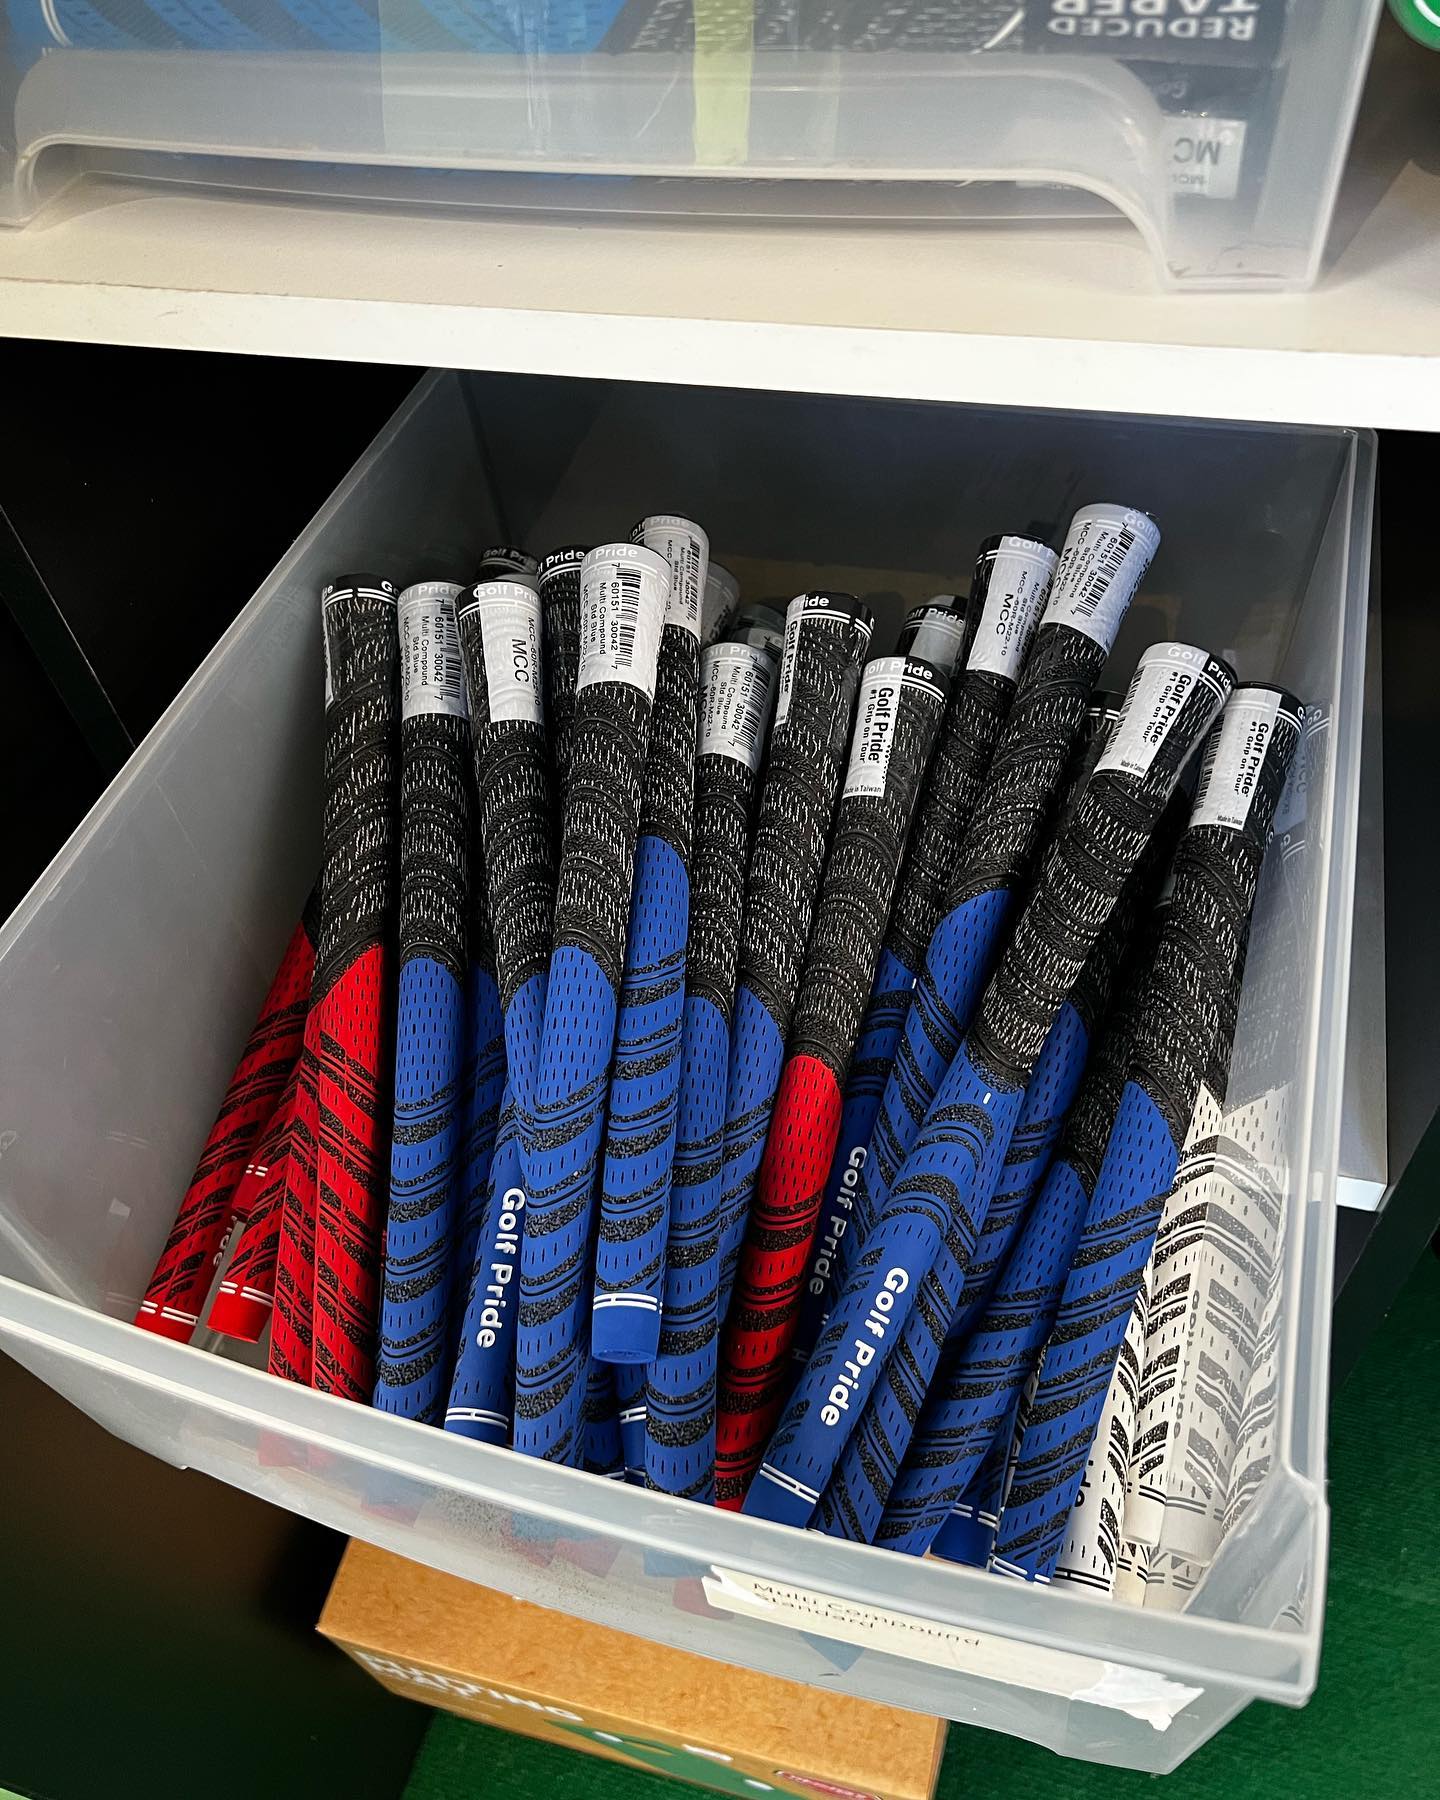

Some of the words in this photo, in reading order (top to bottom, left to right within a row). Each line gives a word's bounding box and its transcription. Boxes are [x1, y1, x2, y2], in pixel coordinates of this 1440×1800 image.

[1048, 16, 1256, 41] REDUCED
[1077, 521, 1092, 545] MCC
[1093, 531, 1109, 553] Multi
[546, 550, 585, 567] Pride
[595, 547, 638, 560] Pride
[1079, 547, 1091, 562] Std
[1098, 537, 1117, 565] 60151
[1017, 571, 1028, 594] MCC
[1069, 553, 1095, 599] Compound
[1070, 563, 1083, 583] Blue
[1079, 569, 1098, 598] 30042
[472, 585, 508, 598] Golf
[610, 581, 620, 612] 60151
[1029, 582, 1041, 604] Multi
[929, 608, 965, 627] Pride
[996, 593, 1014, 635] MCC
[435, 616, 443, 645] 60151
[528, 616, 536, 643] MCC
[610, 620, 618, 651] 30042
[1015, 605, 1033, 652] Compound
[421, 639, 429, 686] Compound
[435, 653, 443, 682] 30042
[511, 637, 530, 684] MCC
[1168, 646, 1206, 664] Golf
[711, 660, 720, 682] MCC
[729, 665, 741, 685] Multi
[890, 660, 933, 680] Pride
[1169, 671, 1178, 682] #1
[719, 681, 727, 695] Std
[740, 670, 753, 697] 60151
[869, 689, 877, 700] #1
[1159, 685, 1172, 703] Grip
[1170, 674, 1191, 705] Golf
[700, 684, 708, 723] MCC
[716, 697, 724, 716] Blue
[719, 687, 735, 730] Compound
[865, 703, 875, 723] Grip
[875, 687, 894, 718] Golf
[1152, 706, 1161, 718] on
[731, 703, 745, 730] 30042
[1150, 705, 1176, 744] Pride
[1250, 721, 1257, 732] #1
[863, 727, 870, 738] on
[868, 722, 889, 761] Pride
[1142, 721, 1156, 742] Tour
[1253, 722, 1269, 753] Golf
[860, 742, 869, 762] Tour
[1243, 736, 1253, 755] Grip
[1240, 758, 1247, 769] on
[1242, 756, 1260, 795] Pride
[1234, 773, 1243, 792] Tour
[838, 1146, 868, 1210] Golf
[494, 1187, 526, 1256] Golf
[809, 1215, 849, 1296] Pride
[476, 1263, 512, 1348] Pride
[864, 1267, 910, 1339] Golf
[820, 1339, 876, 1427] Pride
[827, 1602, 982, 1647] Compound
